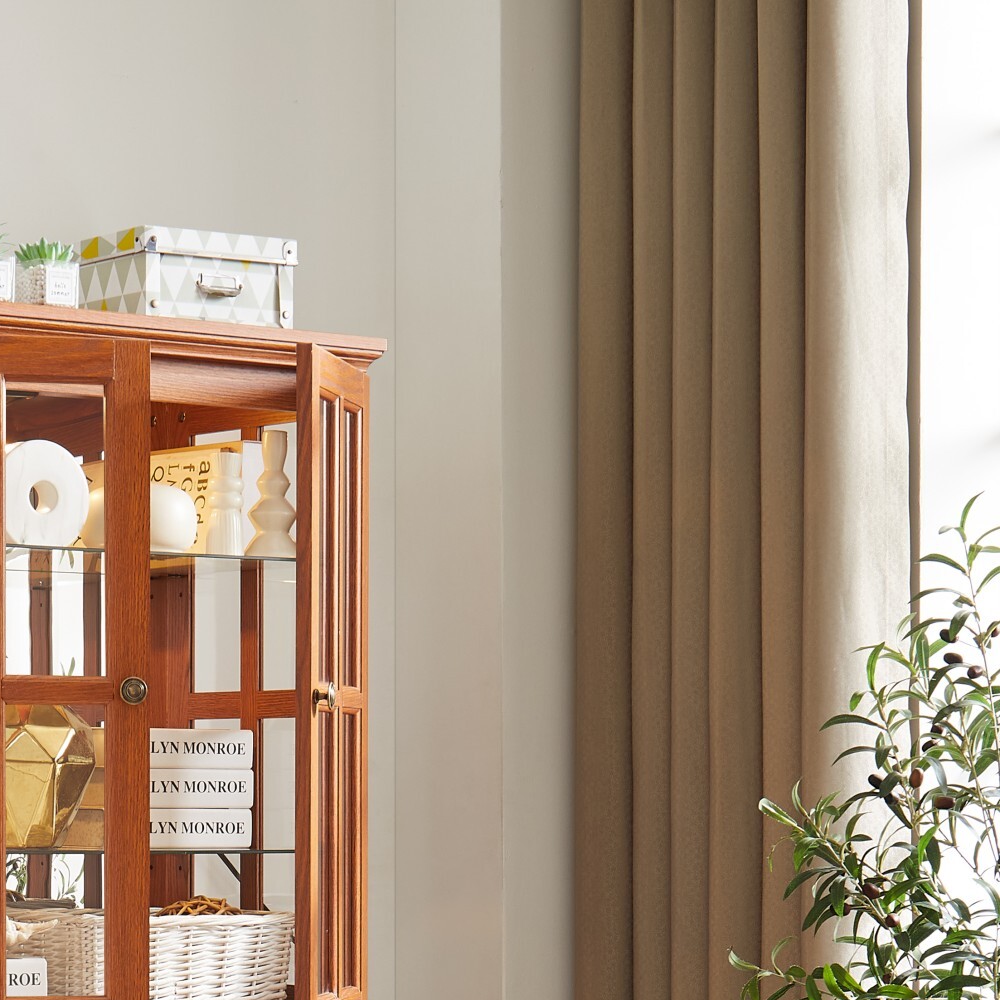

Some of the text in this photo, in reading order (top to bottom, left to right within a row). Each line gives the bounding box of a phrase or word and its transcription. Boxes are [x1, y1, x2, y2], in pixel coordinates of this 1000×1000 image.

[183, 741, 246, 755] MONROE
[184, 780, 247, 794] MONROE
[181, 821, 245, 835] MONROE
